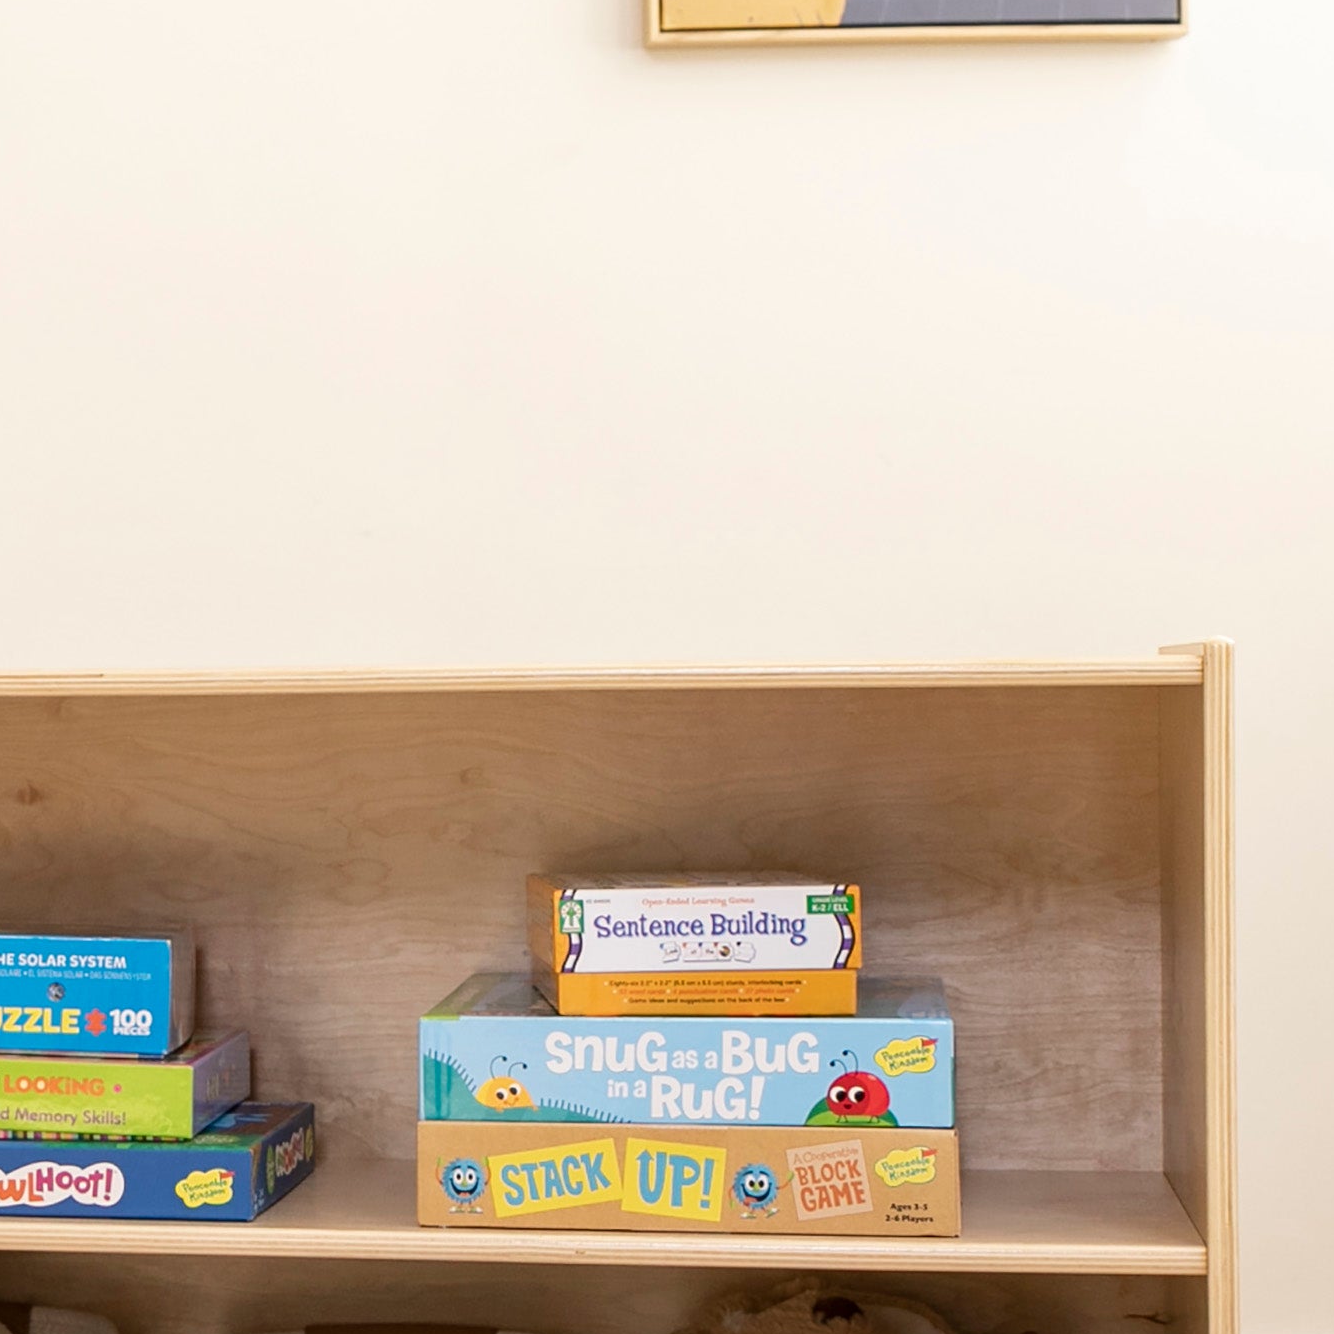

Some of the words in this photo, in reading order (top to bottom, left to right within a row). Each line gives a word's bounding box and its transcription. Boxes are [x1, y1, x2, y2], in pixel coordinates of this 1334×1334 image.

[593, 915, 705, 939] Sentence
[710, 911, 808, 946] Building
[18, 953, 66, 967] SOLAR
[69, 954, 127, 969] SYSTEM
[109, 1008, 153, 1028] 100
[112, 1027, 151, 1036] PIECES
[671, 1049, 699, 1069] as
[704, 1050, 718, 1069] a
[607, 1079, 629, 1099] in
[633, 1079, 647, 1099] a
[14, 1108, 78, 1126] Memory
[82, 1109, 127, 1127] Skills!
[793, 1154, 803, 1166] A
[802, 1147, 859, 1163] Cooperative
[501, 1152, 612, 1207] STACK
[636, 1149, 715, 1209] UP!
[795, 1159, 863, 1187] BLOCK
[800, 1181, 867, 1213] GAME
[890, 1203, 912, 1213] Ages
[914, 1203, 928, 1211] 3-5
[885, 1215, 900, 1223] 2-6
[902, 1215, 934, 1224] Players
